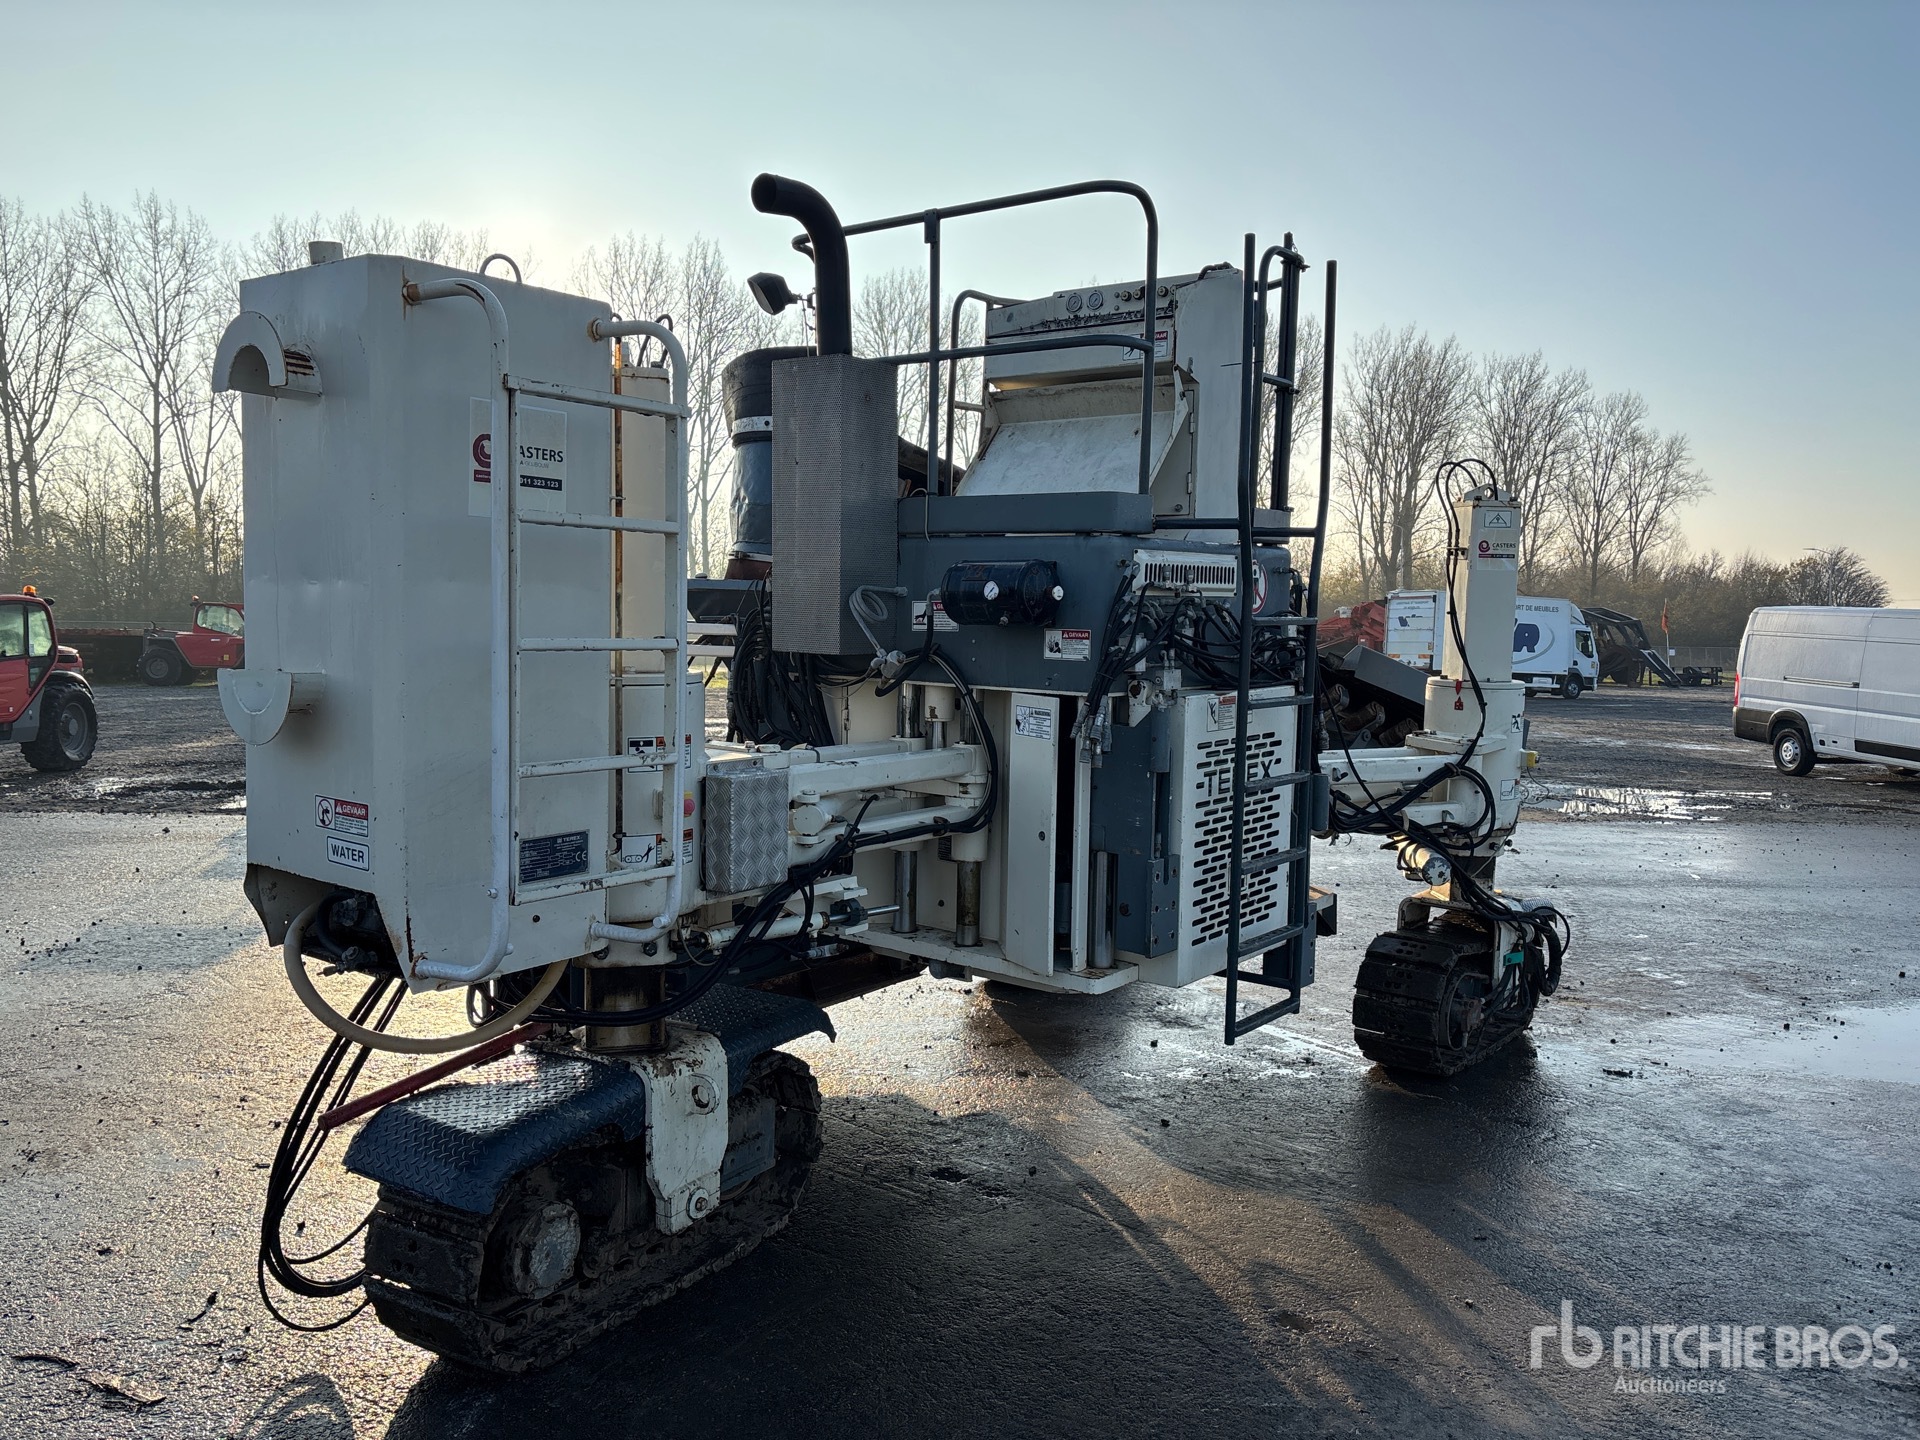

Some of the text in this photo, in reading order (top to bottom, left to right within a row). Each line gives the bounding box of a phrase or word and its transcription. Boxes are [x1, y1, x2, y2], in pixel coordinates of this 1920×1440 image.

[533, 479, 545, 487] 323
[1534, 605, 1559, 613] MEUBLES
[1203, 759, 1274, 797] TEEX
[342, 804, 366, 816] GEVAAR
[331, 843, 365, 864] WATER
